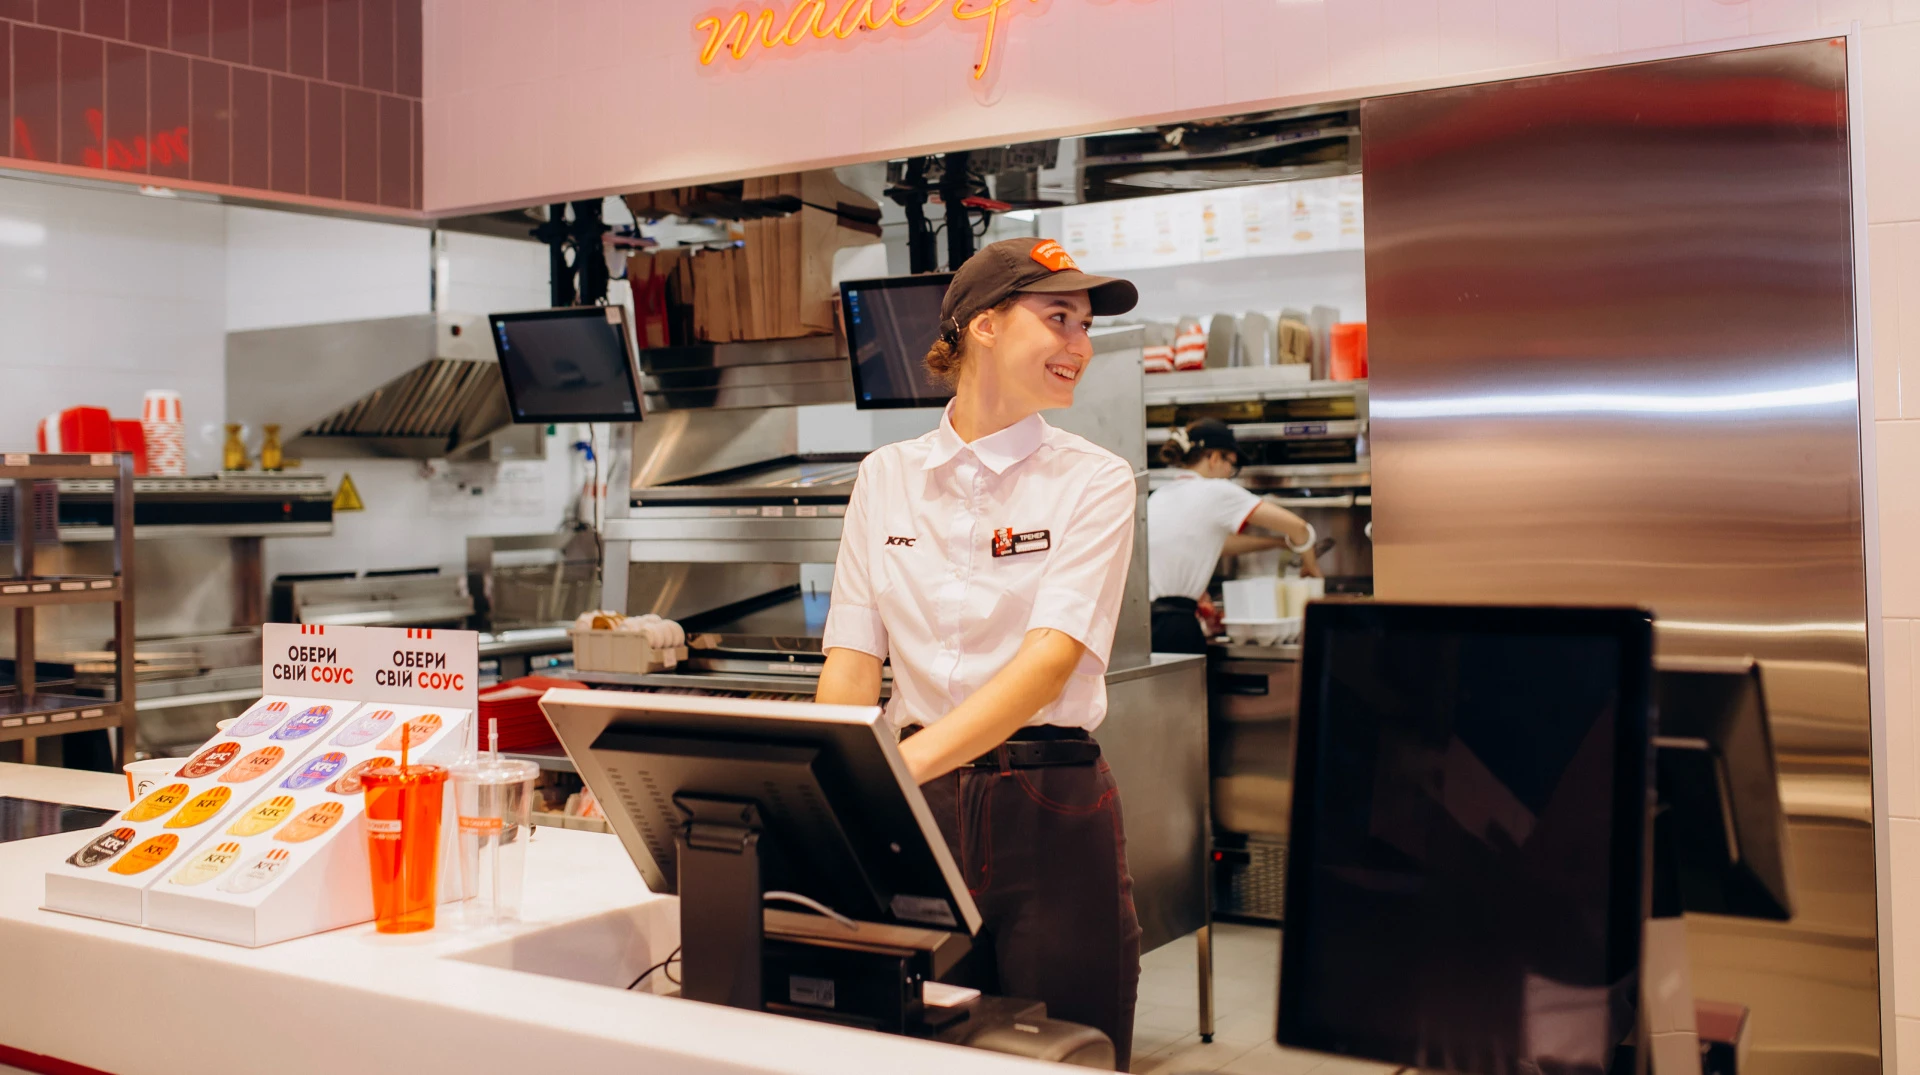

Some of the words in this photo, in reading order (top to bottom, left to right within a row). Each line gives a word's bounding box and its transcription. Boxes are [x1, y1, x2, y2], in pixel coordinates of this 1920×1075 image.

[884, 535, 916, 547] KFC
[1019, 532, 1045, 541] ТРЕНЕР
[288, 645, 337, 664] ОБЕРИ
[392, 650, 446, 669] ОБЕРИ
[272, 663, 306, 682] СВІЙ
[311, 666, 353, 684] СОУС
[375, 669, 413, 688] СВІЙ
[418, 672, 464, 691] СОУС
[298, 715, 325, 725] KFC
[204, 752, 231, 761] KFC
[250, 755, 275, 765] KFC
[310, 761, 338, 773] KFC
[155, 794, 178, 804] KFC
[196, 799, 222, 808] KFC
[258, 807, 285, 818] KFC
[307, 813, 334, 824] KFC
[100, 836, 125, 851] KFC
[144, 844, 168, 855] KFC
[204, 854, 232, 864] KFC
[253, 860, 280, 872] KFC
